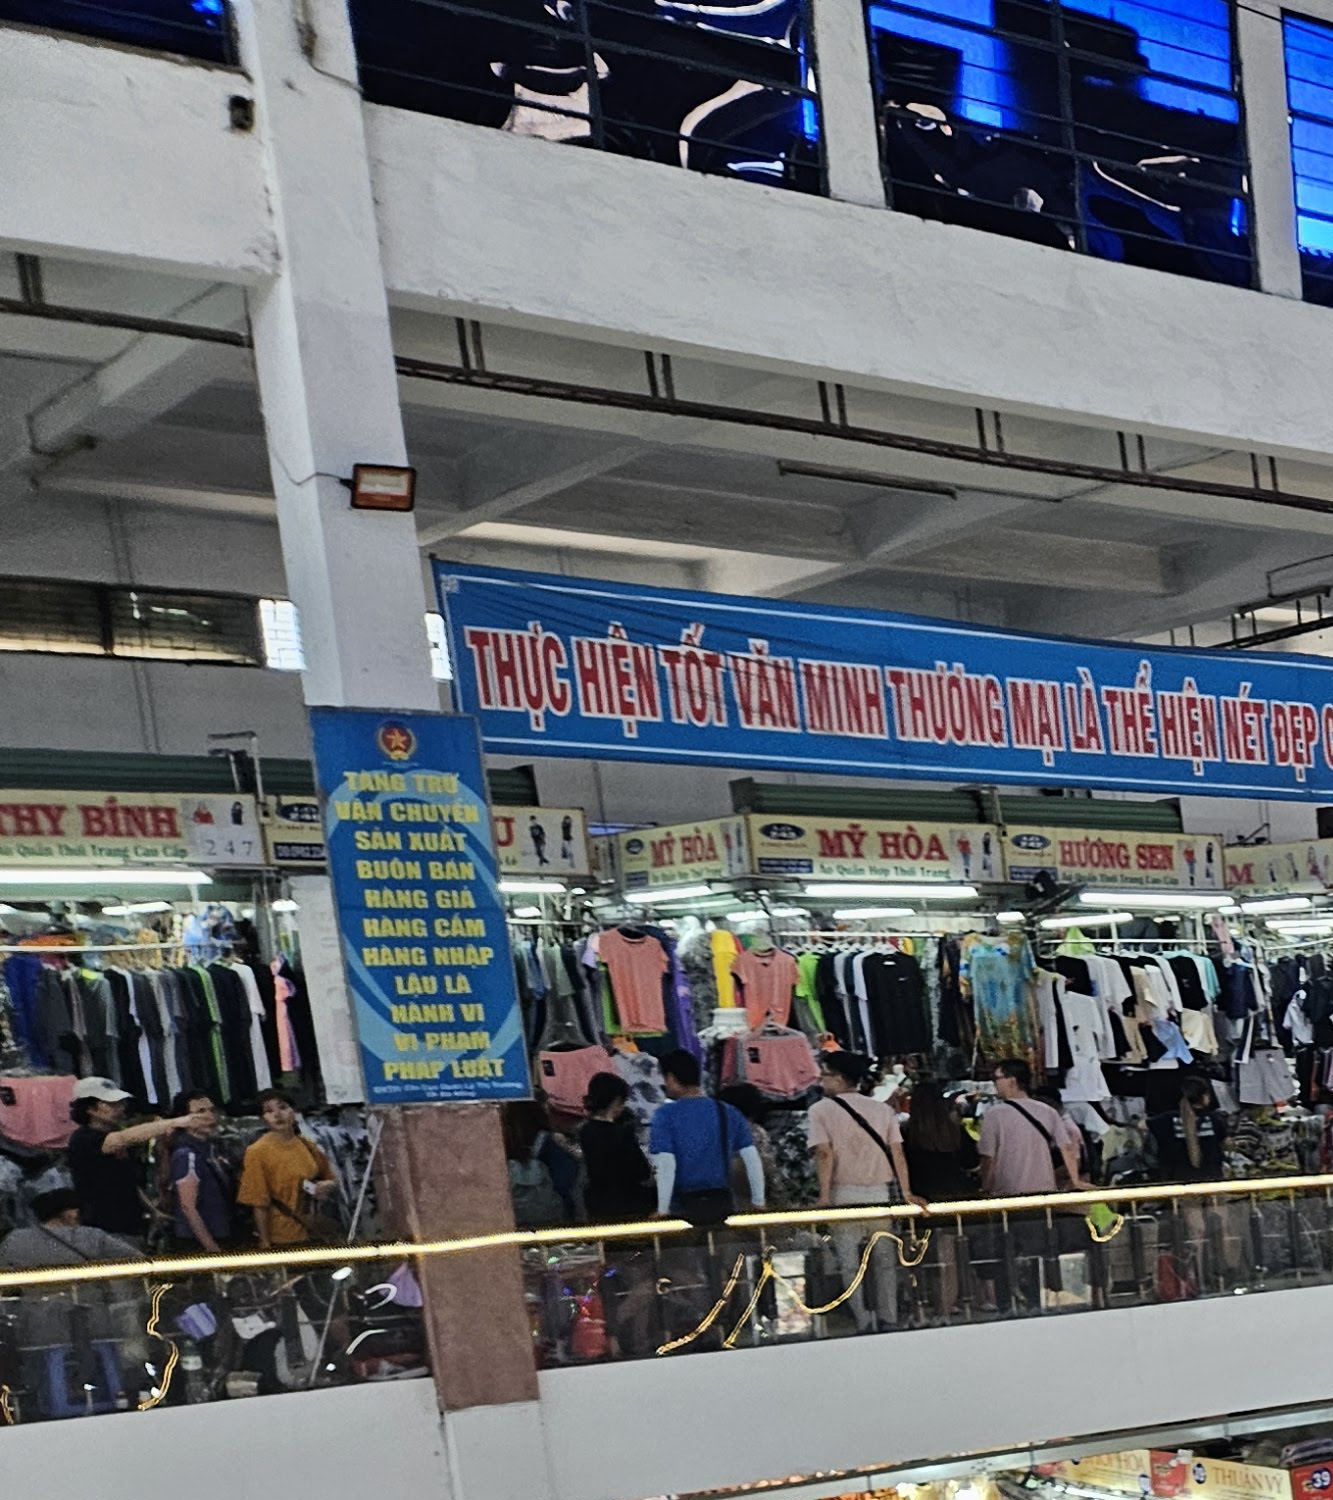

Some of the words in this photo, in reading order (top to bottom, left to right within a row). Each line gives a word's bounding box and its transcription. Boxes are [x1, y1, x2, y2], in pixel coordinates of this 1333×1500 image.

[465, 622, 571, 730] THỰC
[573, 621, 660, 737] HIỆN
[659, 622, 728, 728] TỐT
[730, 638, 799, 731] VĂN
[800, 659, 888, 739] MINH
[1005, 678, 1065, 766] MẠI
[1065, 666, 1103, 754] LÀ
[1103, 660, 1159, 759] THỂ
[1159, 677, 1221, 776] HIỆN
[1221, 682, 1269, 765] NÉT
[1272, 702, 1318, 782] ĐẸP
[78, 795, 181, 838] BÌNH
[879, 824, 950, 862] HÒA
[1136, 844, 1175, 871] SEN
[1310, 1469, 1331, 1490] 39
